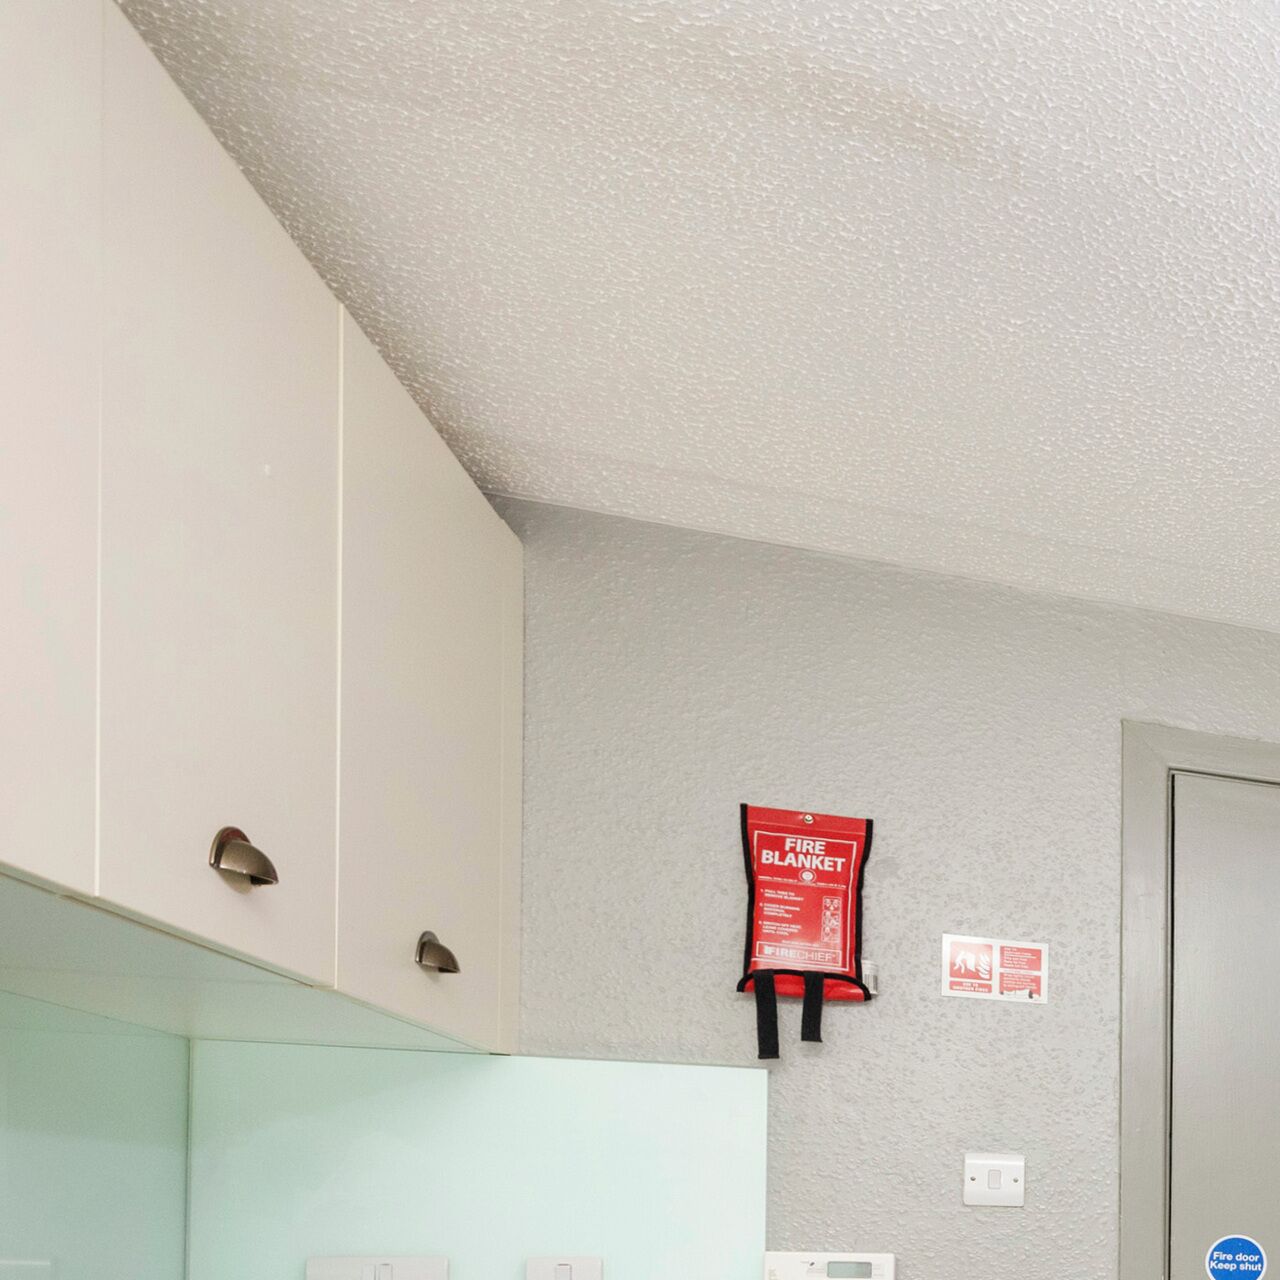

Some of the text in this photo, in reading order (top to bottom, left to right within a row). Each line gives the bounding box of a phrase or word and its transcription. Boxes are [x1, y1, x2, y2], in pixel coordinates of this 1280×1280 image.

[785, 837, 826, 855] FIRE
[761, 849, 846, 872] BLANKET
[1213, 1251, 1260, 1262] Fire door
[1210, 1260, 1262, 1272] Keep shut
